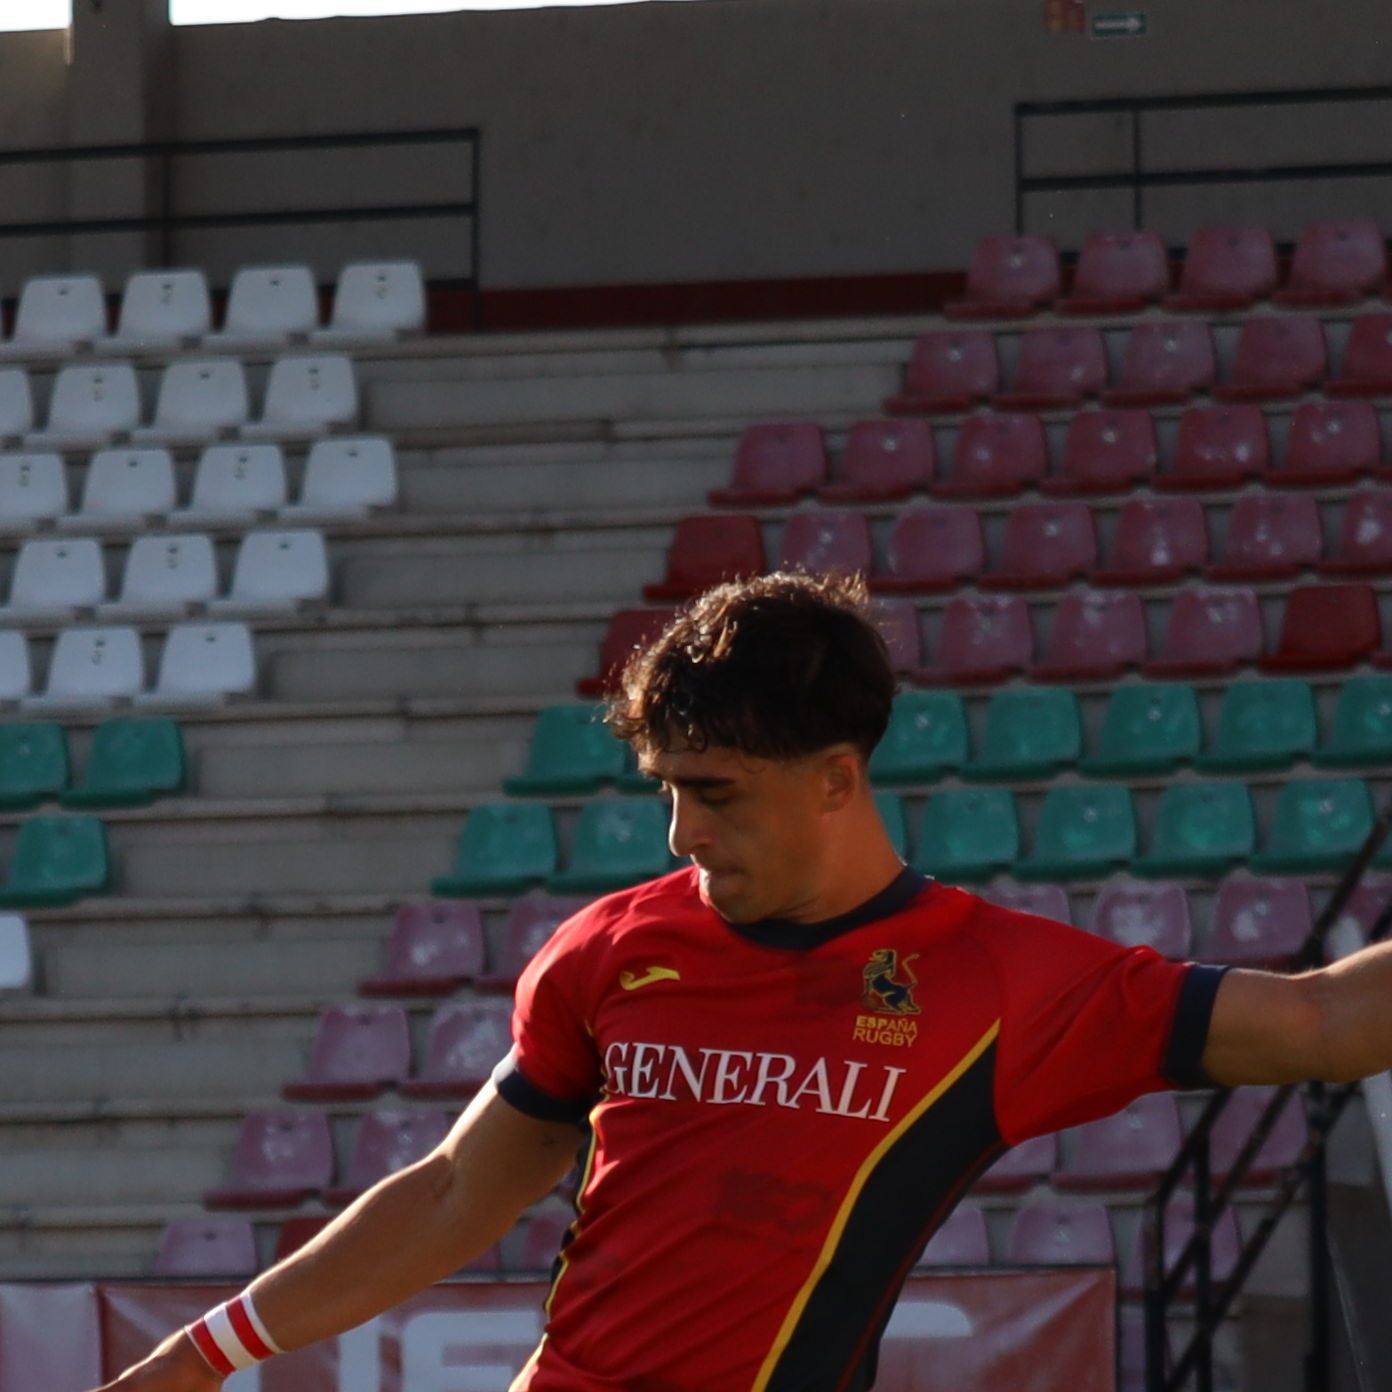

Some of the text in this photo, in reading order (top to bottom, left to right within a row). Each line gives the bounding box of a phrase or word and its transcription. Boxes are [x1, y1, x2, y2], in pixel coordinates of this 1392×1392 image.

[856, 1015, 918, 1033] ESPAÑA
[852, 1027, 918, 1048] RUGBY
[604, 1041, 907, 1122] GENERALI
